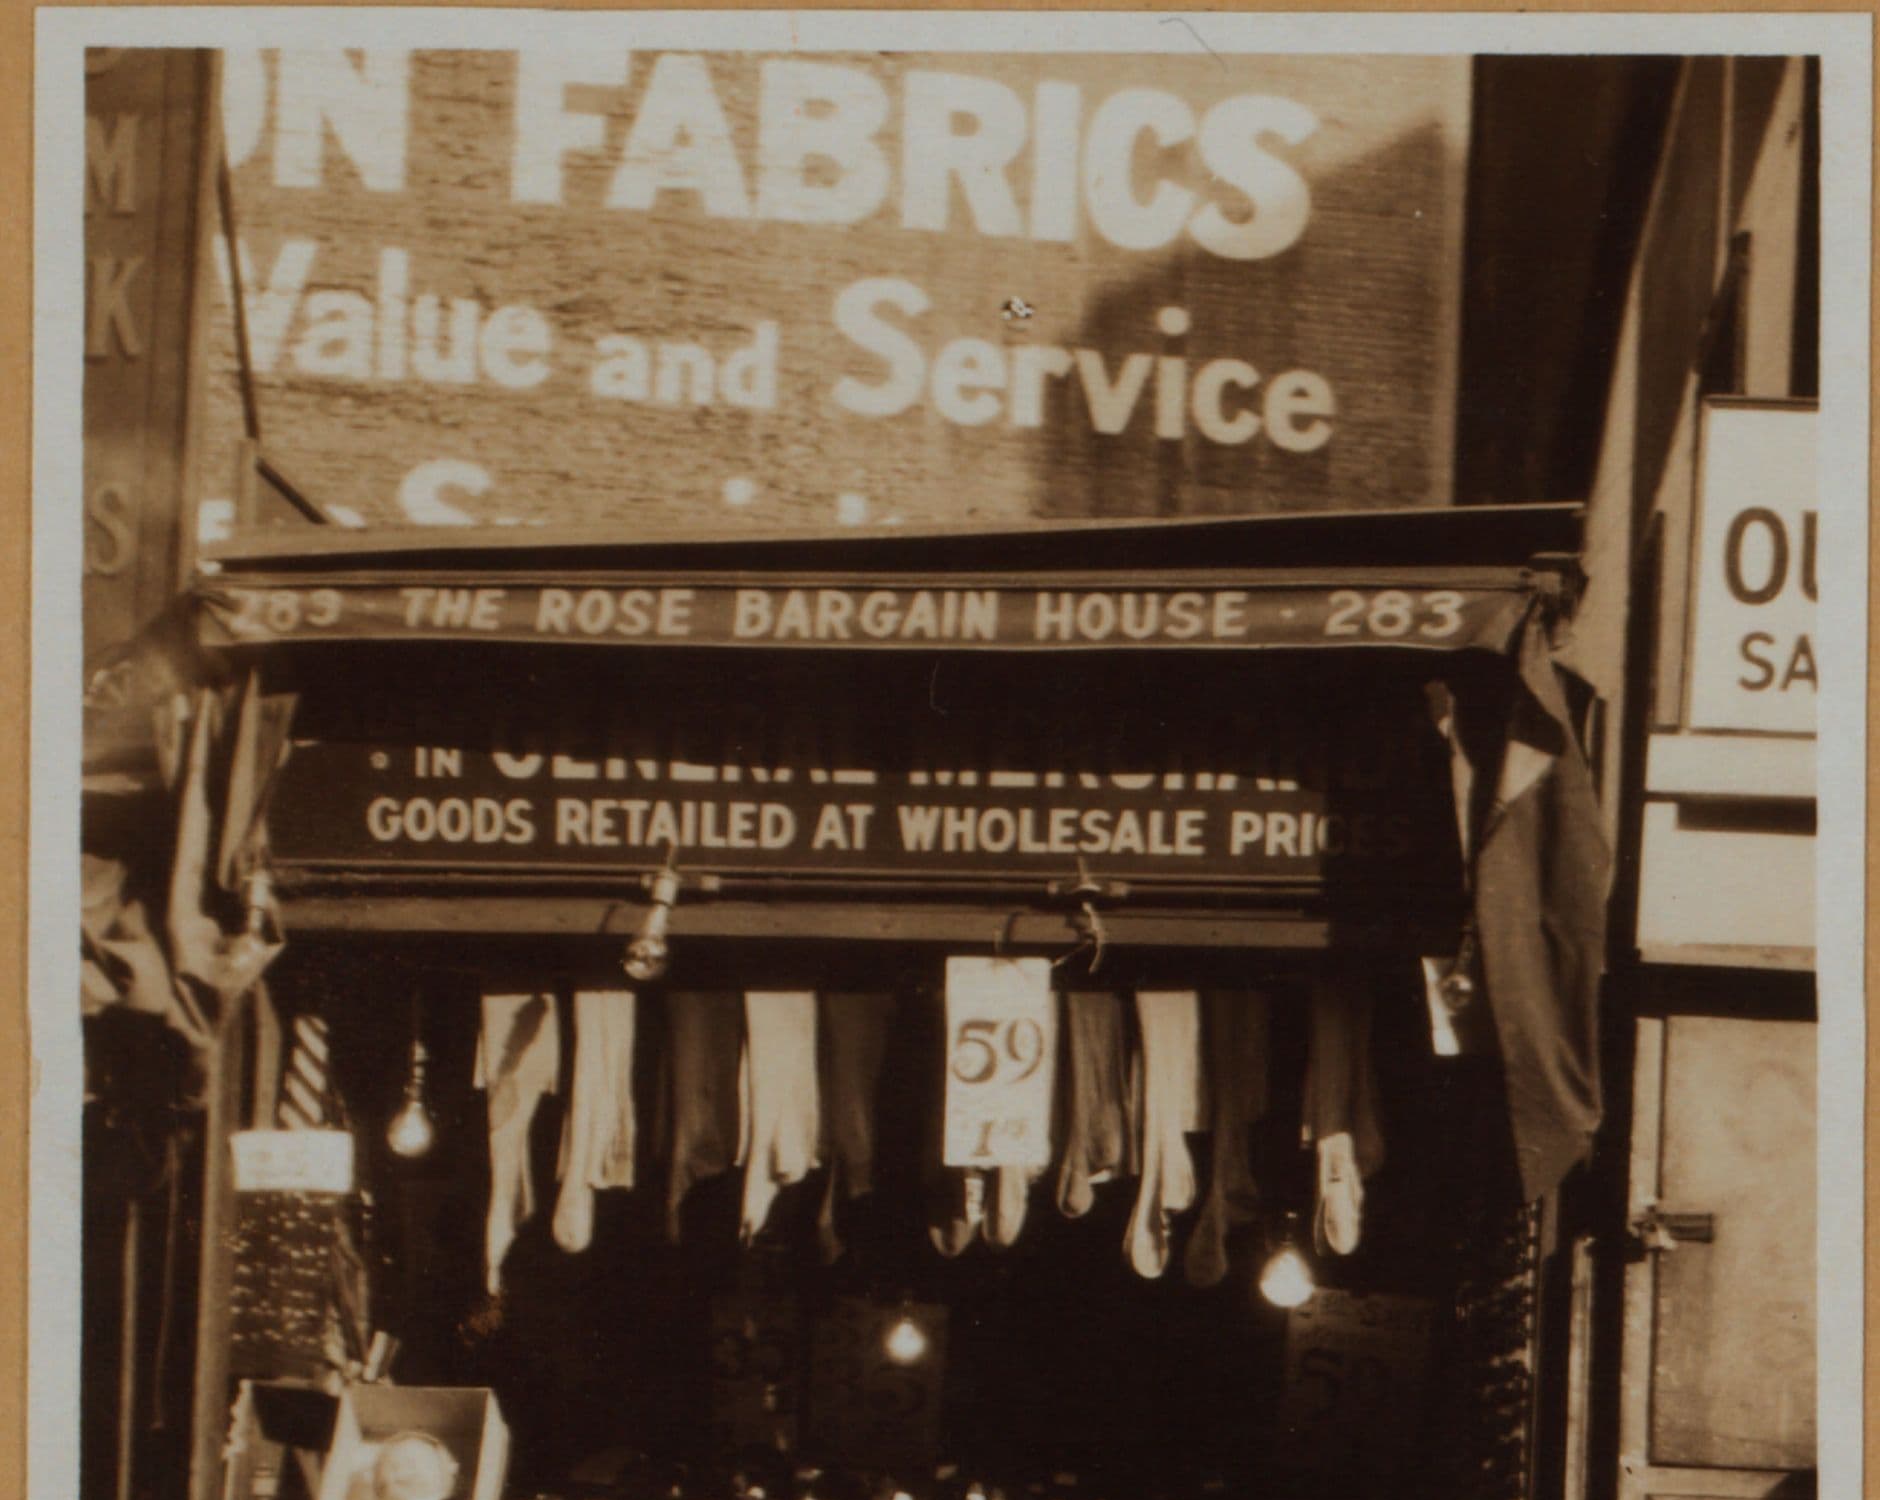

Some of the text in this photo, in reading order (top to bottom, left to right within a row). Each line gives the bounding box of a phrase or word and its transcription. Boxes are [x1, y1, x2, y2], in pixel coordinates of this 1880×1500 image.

[510, 50, 1318, 261] FABRICS
[212, 234, 1337, 453] Value and Service
[401, 588, 504, 630] THE
[534, 589, 694, 635] ROSE
[732, 590, 999, 640] BARGAIN
[1034, 591, 1249, 640] HOUSE
[1322, 590, 1466, 637] 283
[414, 746, 462, 778] IN
[367, 798, 535, 843] GOODS
[555, 800, 797, 849] RETAILED
[812, 803, 875, 850] AT
[898, 804, 1207, 856] WHOLESALE
[953, 1017, 1045, 1086] 59
